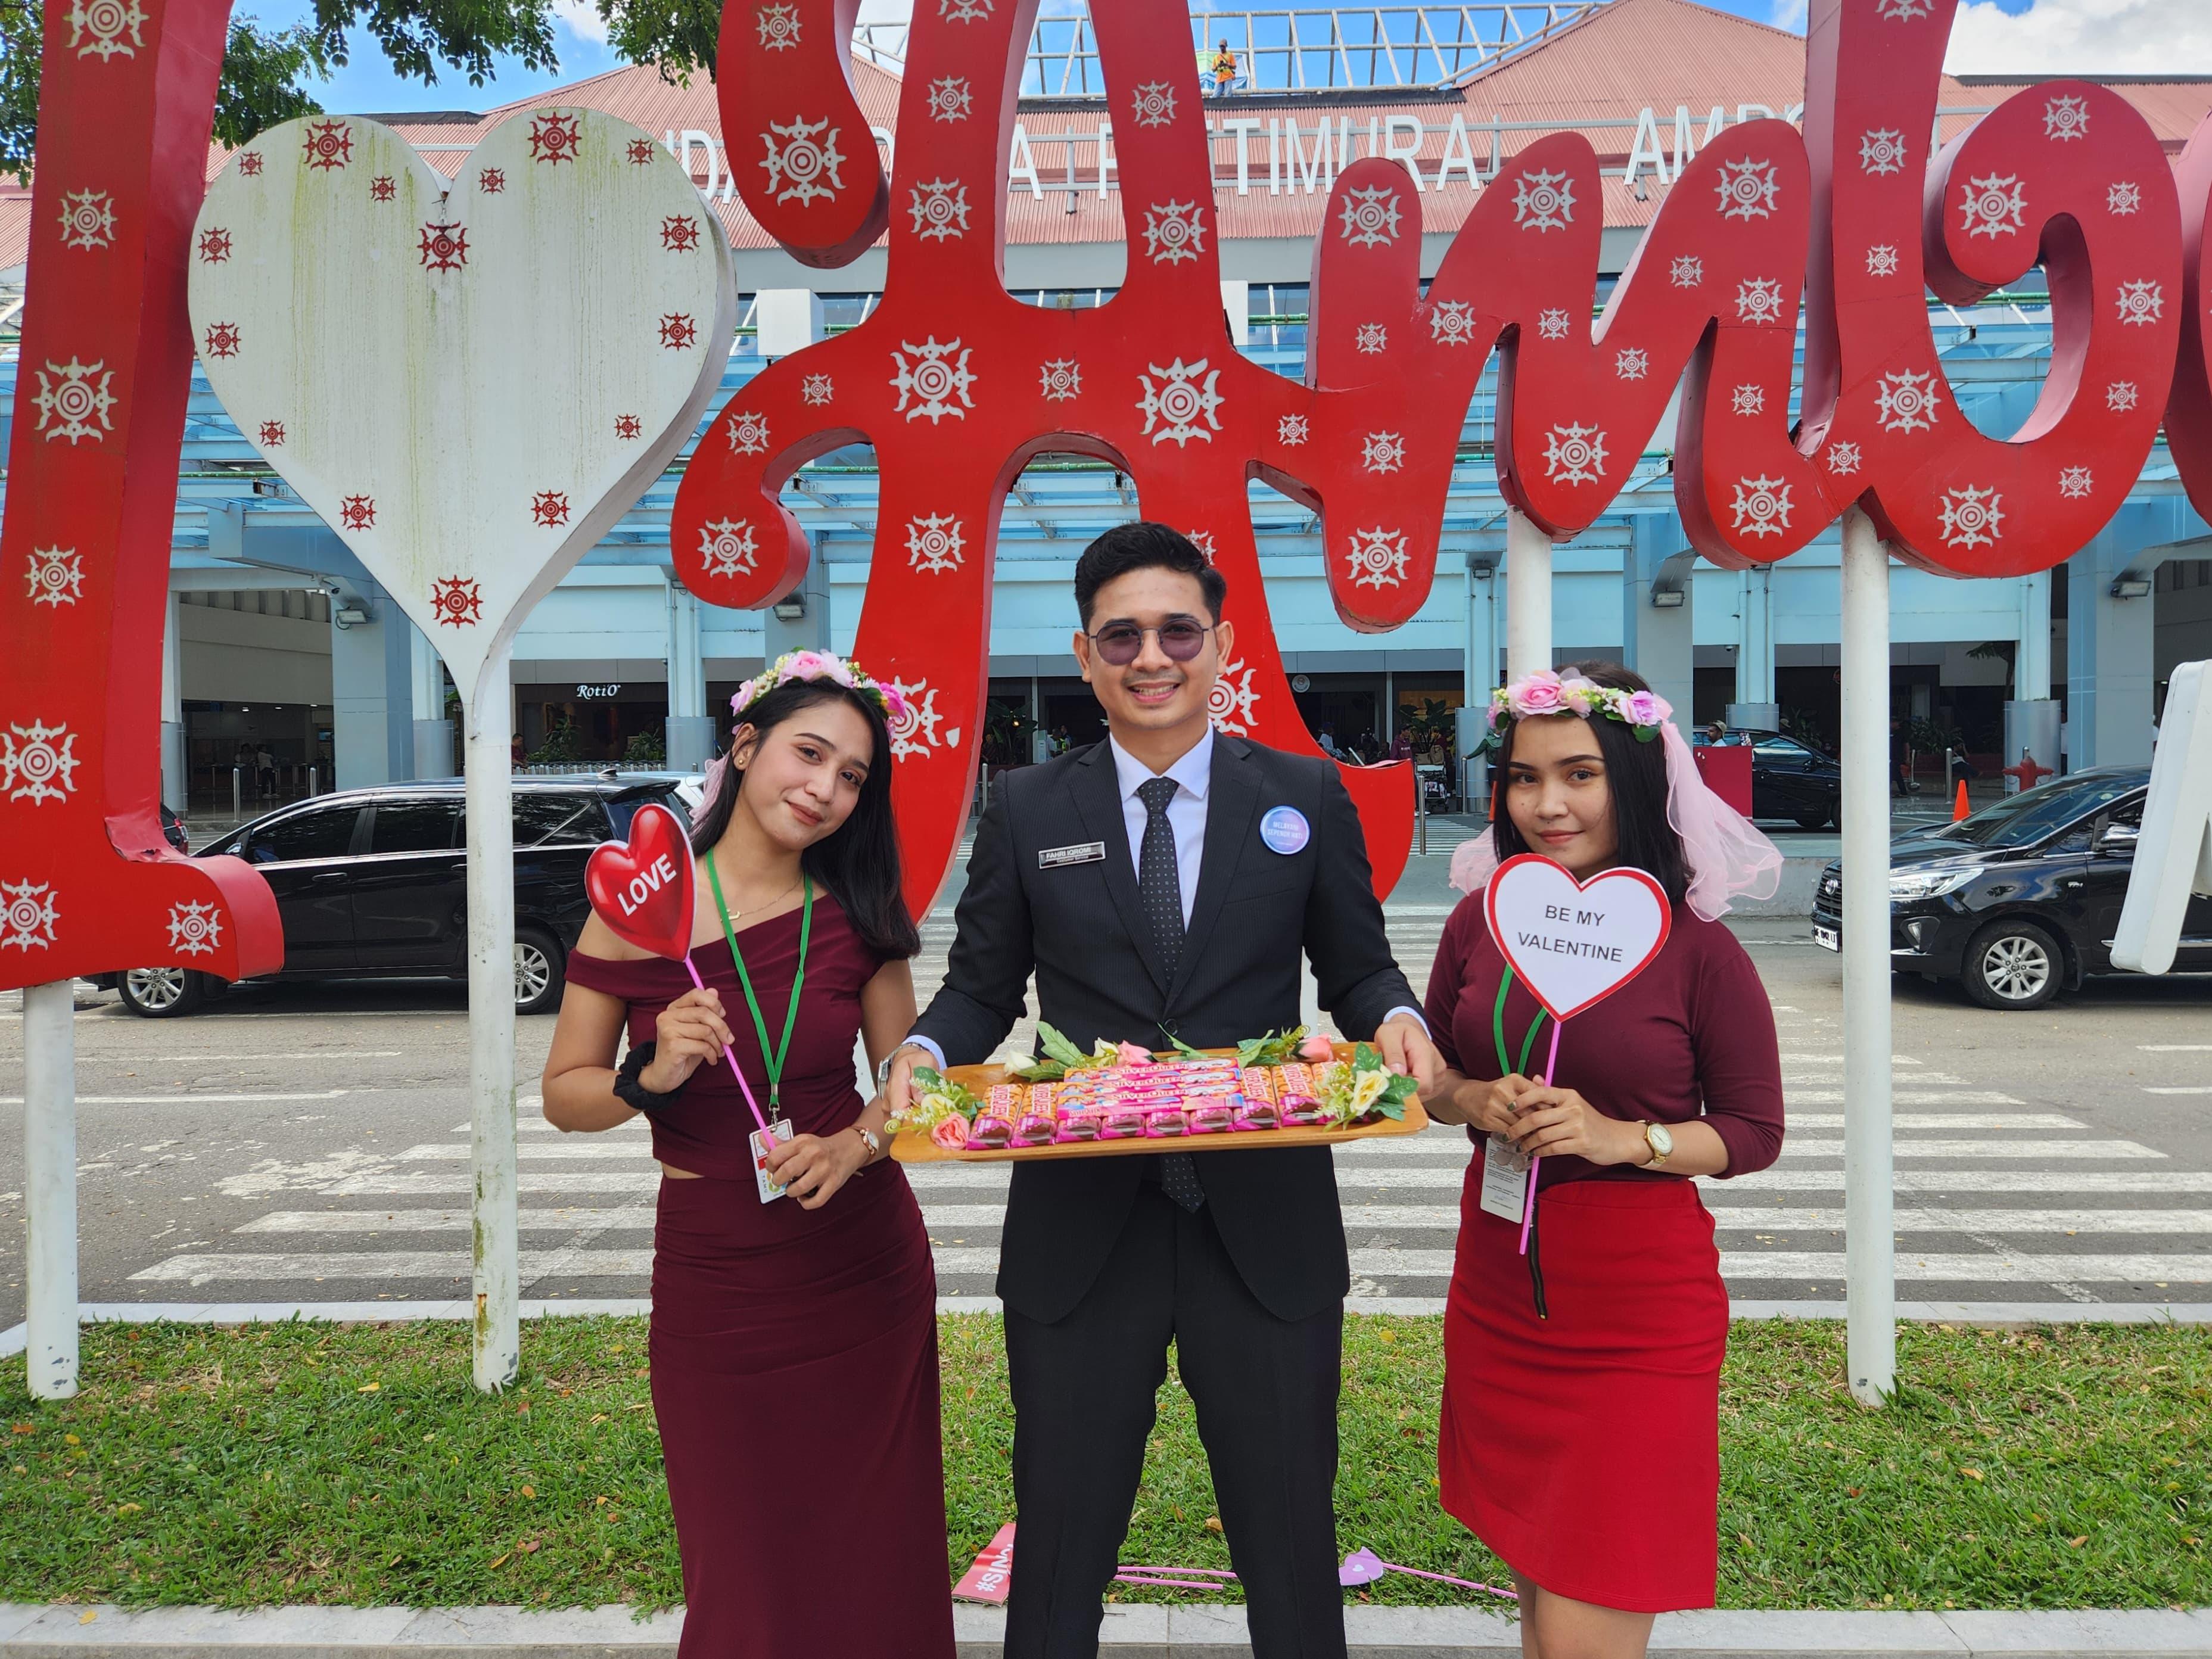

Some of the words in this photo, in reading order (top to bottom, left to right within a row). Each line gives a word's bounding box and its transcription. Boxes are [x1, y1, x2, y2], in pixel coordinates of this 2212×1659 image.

[1046, 851, 1066, 859] FAHRI
[1067, 846, 1092, 856] IQROMI
[618, 853, 677, 916] LOVE
[1545, 905, 1571, 922] BE
[1577, 910, 1605, 926] MY
[1518, 932, 1623, 963] VALENTINE
